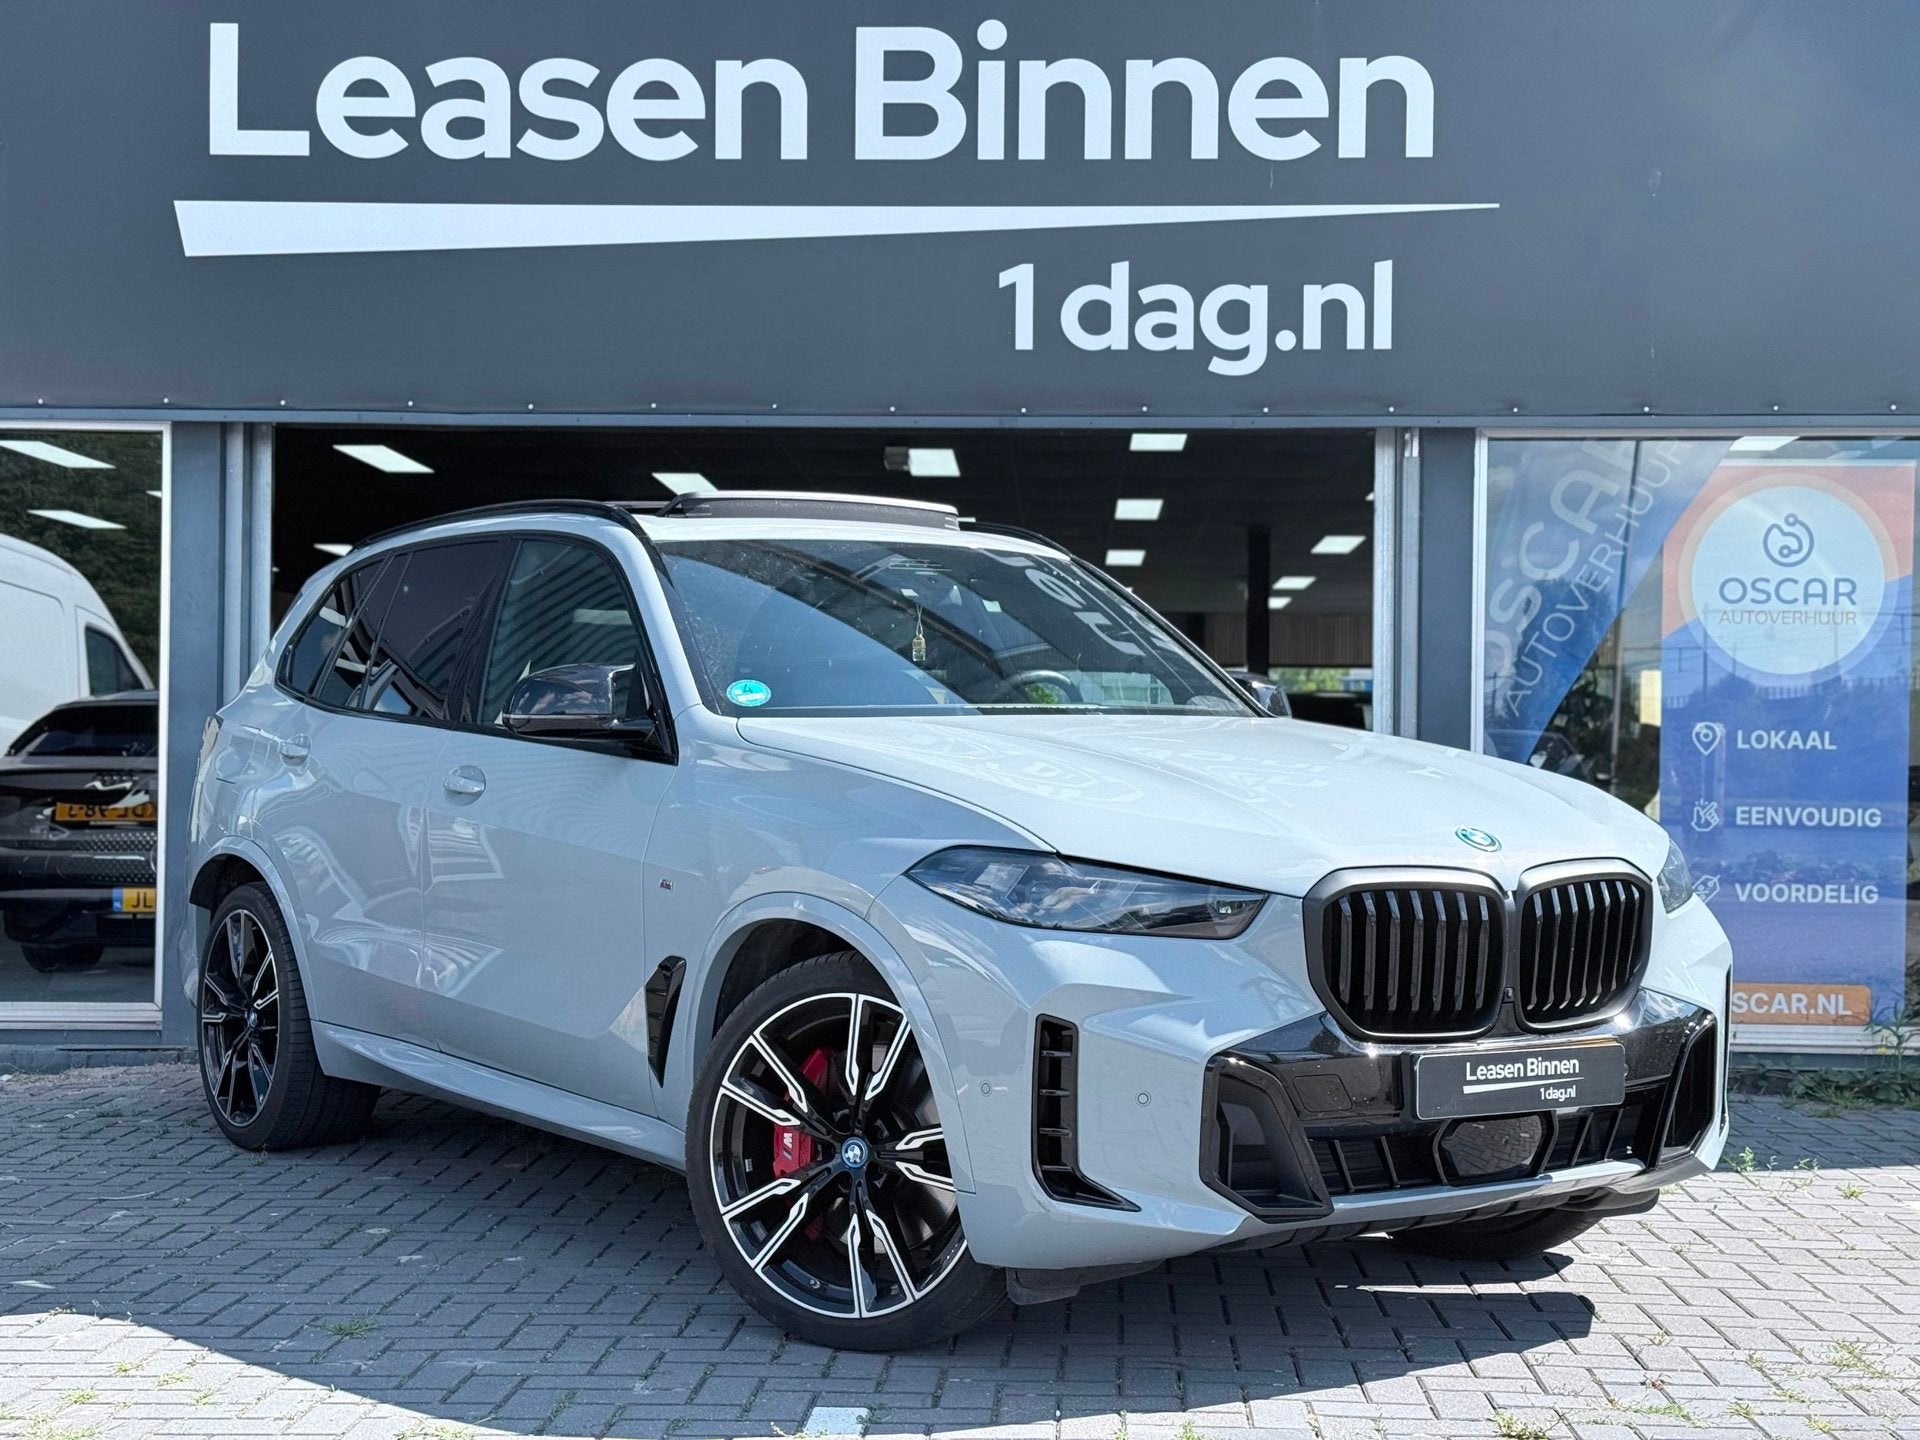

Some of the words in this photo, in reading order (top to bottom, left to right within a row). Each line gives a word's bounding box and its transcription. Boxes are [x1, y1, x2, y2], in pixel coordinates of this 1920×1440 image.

[208, 22, 808, 162] Leasen
[855, 19, 1435, 162] Binnen
[1718, 576, 1858, 606] OSCAR
[1718, 610, 1857, 626] AUTOVERHUUR
[1736, 730, 1838, 750] LOKAAL
[1735, 806, 1882, 828] EENVOUDIG
[1734, 883, 1880, 905] VOORDELIG
[1466, 1061, 1525, 1081] Leasen
[1526, 1057, 1580, 1077] Binnen
